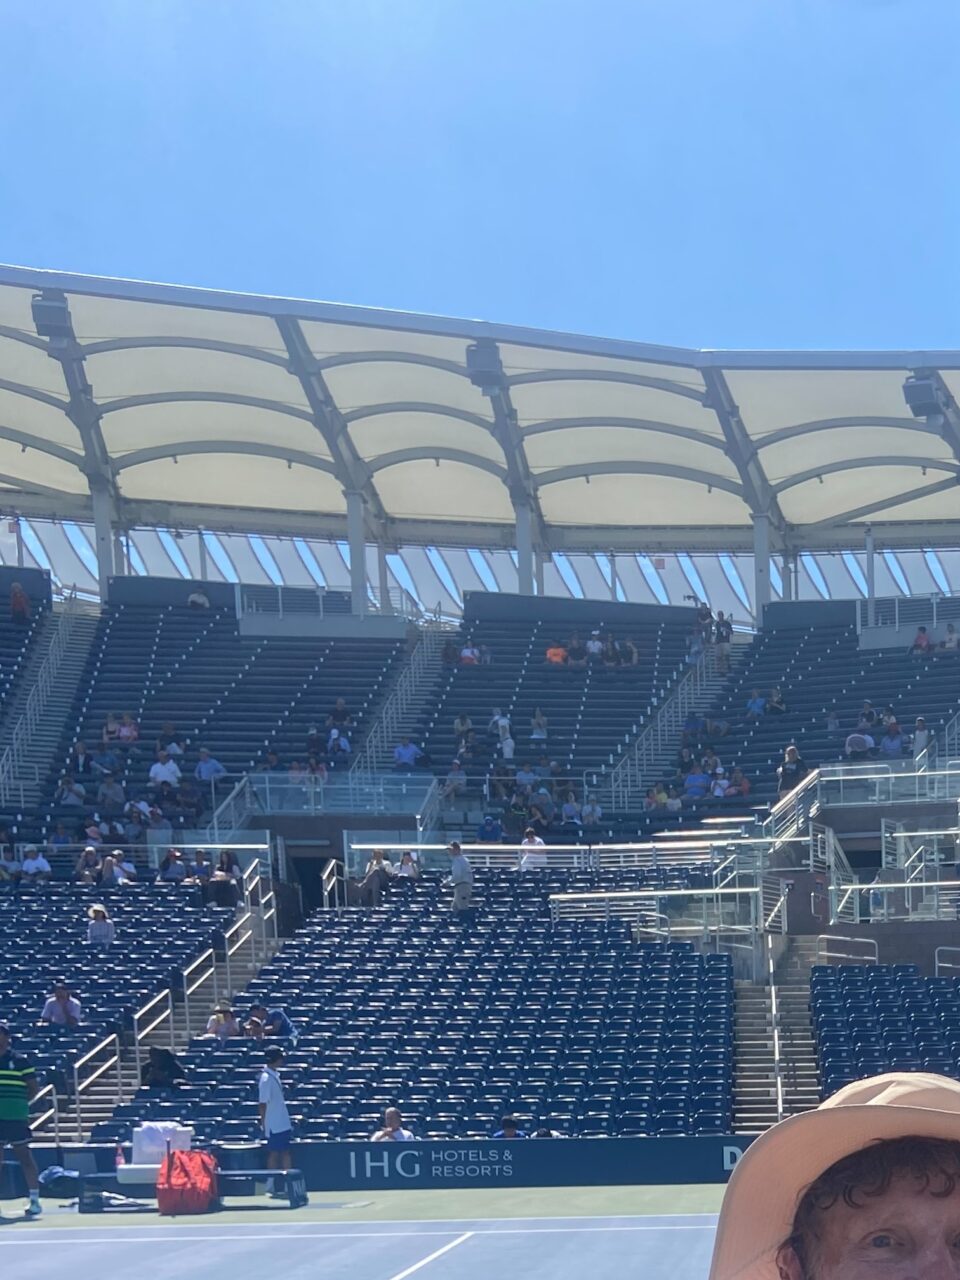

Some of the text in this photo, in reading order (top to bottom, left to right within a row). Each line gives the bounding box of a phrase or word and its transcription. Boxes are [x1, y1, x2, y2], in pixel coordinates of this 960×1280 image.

[350, 1150, 513, 1178] IHG HOTELS &
[431, 1164, 513, 1177] RESORTS
